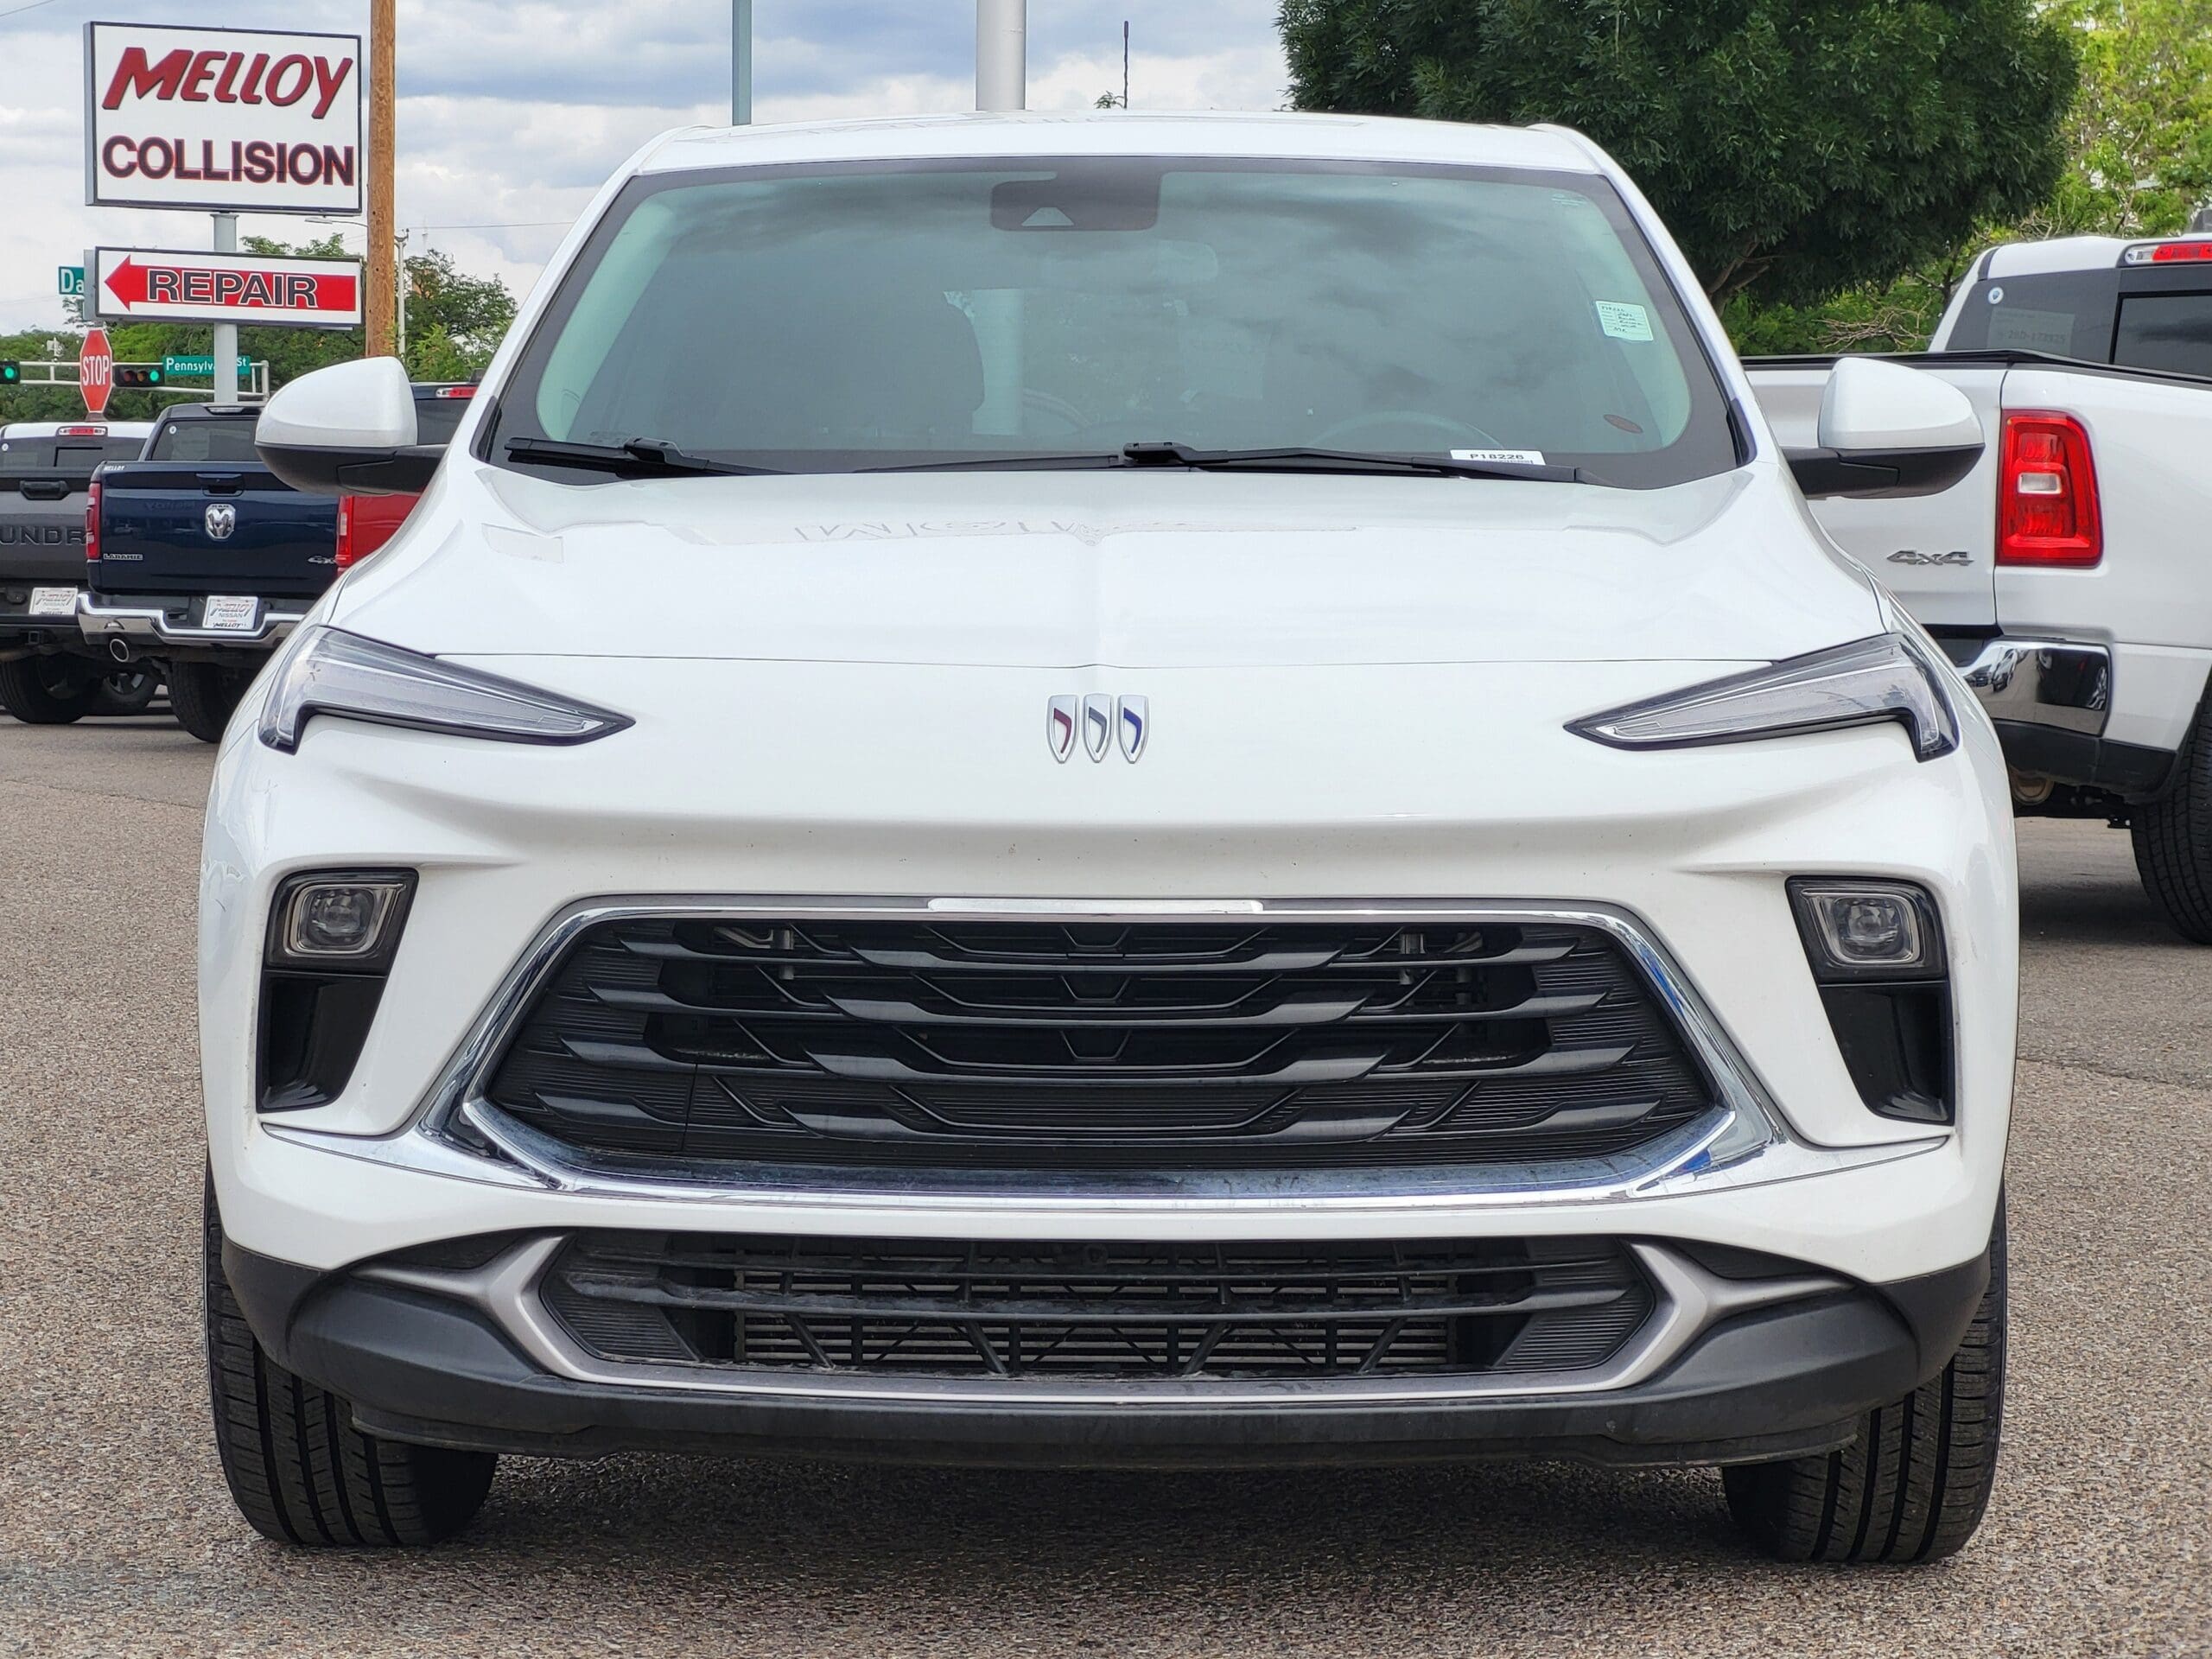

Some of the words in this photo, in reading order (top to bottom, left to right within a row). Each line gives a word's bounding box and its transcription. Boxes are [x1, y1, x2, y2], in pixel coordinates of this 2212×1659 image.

[102, 47, 353, 119] MELLOY
[102, 135, 355, 187] COLLISION
[147, 269, 319, 308] REPAIR
[82, 355, 110, 386] STOP
[166, 357, 214, 373] Pennsylv
[237, 357, 246, 367] St
[1886, 550, 1974, 567] 4x4
